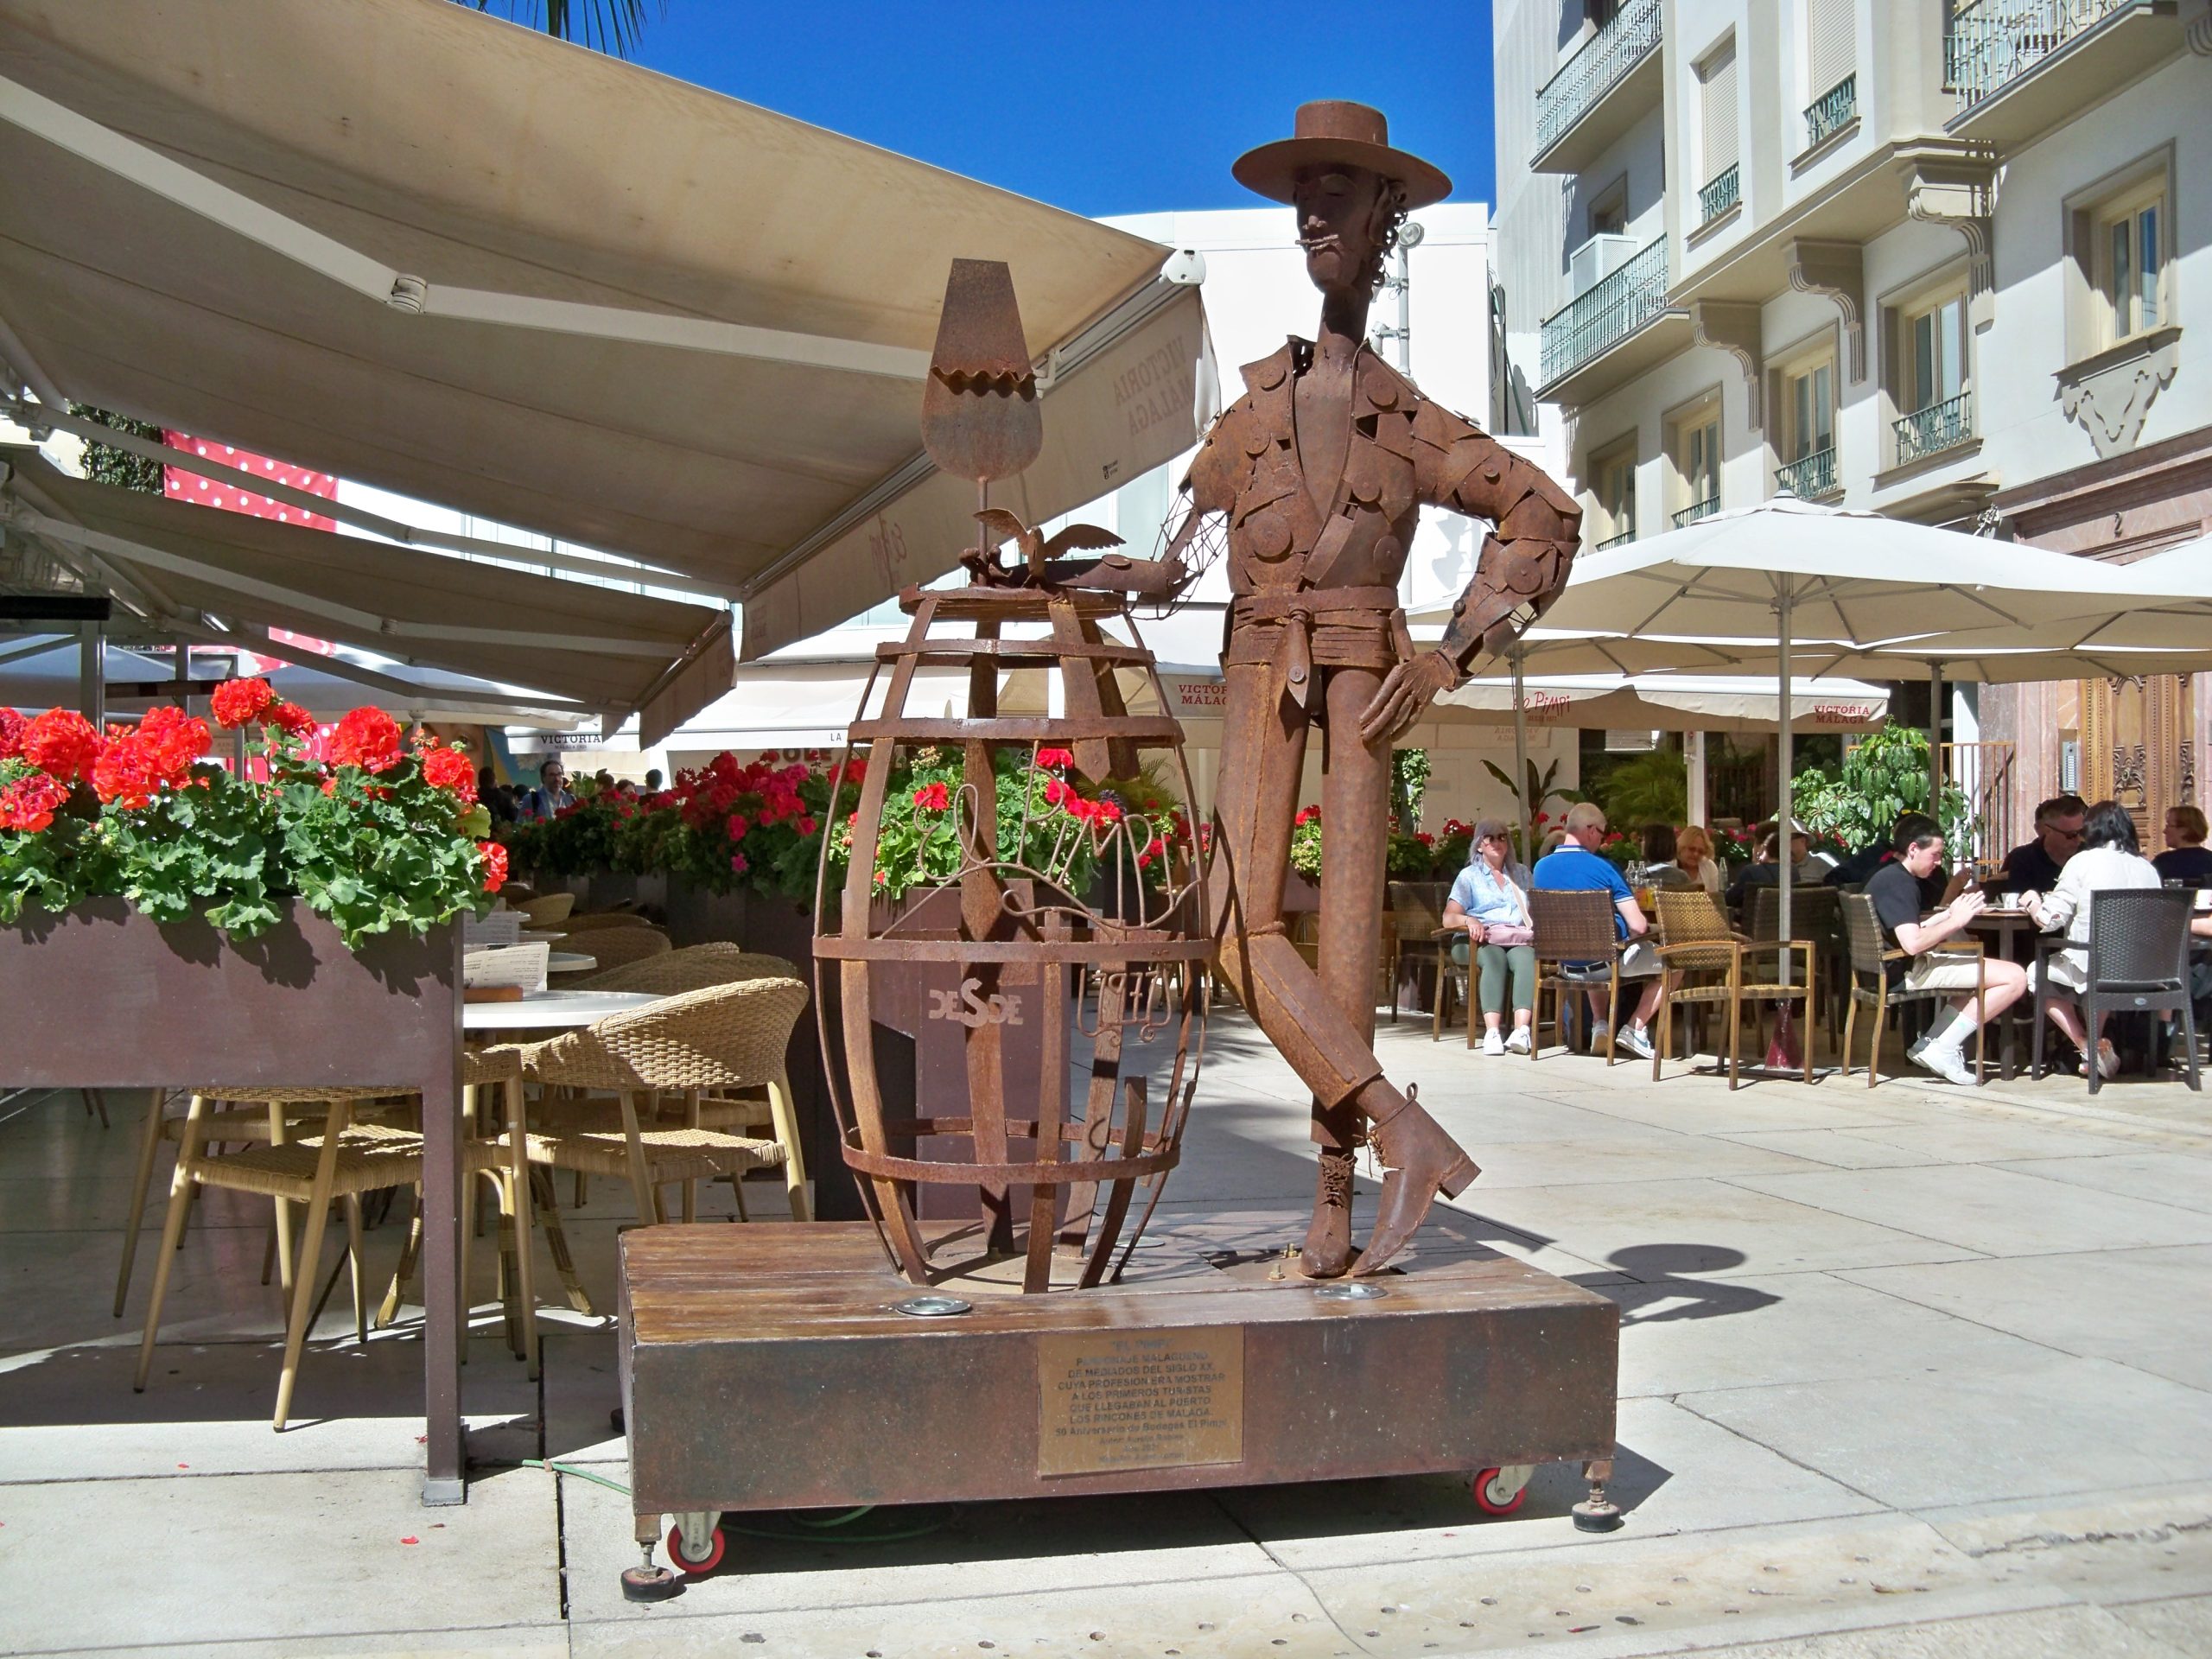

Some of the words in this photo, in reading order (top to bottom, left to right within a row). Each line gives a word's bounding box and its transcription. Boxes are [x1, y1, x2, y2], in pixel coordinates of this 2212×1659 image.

[2113, 512, 2123, 539] 2
[1181, 694, 1227, 705] MÁLA
[1813, 705, 1870, 715] VICTORIA
[540, 734, 601, 744] VICTORIA
[830, 733, 842, 741] LA
[928, 977, 1024, 1028] DESDE
[1068, 1370, 1082, 1379] DE
[1085, 1366, 1140, 1378] MEDIADOS
[1143, 1365, 1162, 1375] DEL
[1166, 1363, 1197, 1373] SIGLO
[1058, 1380, 1086, 1390] CUYA
[1151, 1376, 1173, 1385] ERA
[1174, 1372, 1225, 1383] MOSTRAR
[1071, 1392, 1080, 1401] A
[1082, 1390, 1102, 1401] LOS
[1106, 1388, 1159, 1399] PRIMEROS
[1162, 1385, 1211, 1396] TURISTAS
[1070, 1403, 1091, 1413] QUE
[1095, 1400, 1151, 1411] LLEGABAN
[1153, 1399, 1166, 1408] AL
[1170, 1396, 1211, 1407] PUERTO
[1070, 1414, 1091, 1424] LOS
[1094, 1411, 1147, 1423] RINCONES
[1150, 1409, 1164, 1419] DE
[1070, 1424, 1124, 1436] Aniversario
[1142, 1421, 1185, 1433] Bodegas
